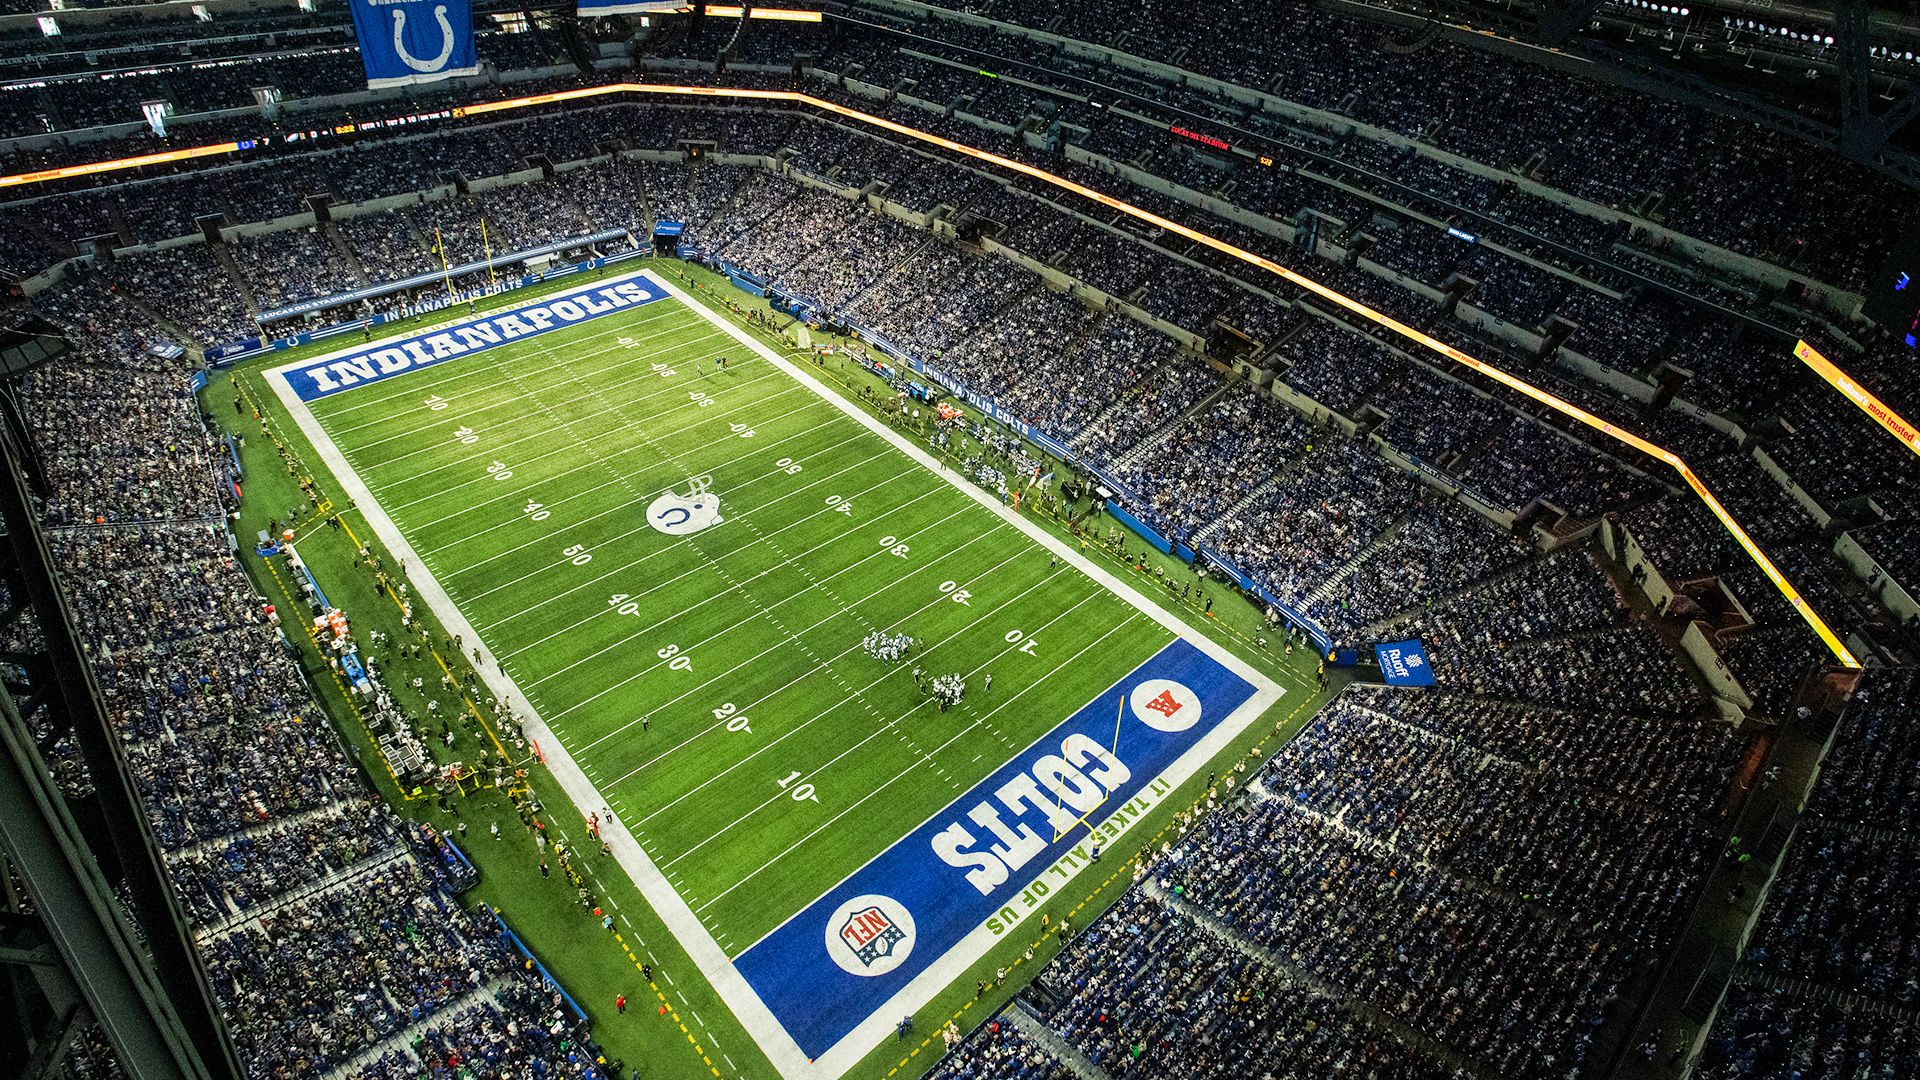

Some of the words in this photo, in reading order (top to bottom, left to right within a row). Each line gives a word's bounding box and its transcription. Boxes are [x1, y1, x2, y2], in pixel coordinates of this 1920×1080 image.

[1171, 126, 1189, 138] LUCAS
[1189, 132, 1199, 141] OIL
[1200, 136, 1229, 150] STADIUM
[39, 171, 60, 179] trusted
[552, 239, 576, 249] LUCAS
[589, 229, 622, 241] STADIUM
[263, 307, 294, 319] LUCAS
[294, 303, 311, 312] OIL
[312, 293, 355, 307] STADIUM
[383, 290, 481, 323] INDIANAPOLIS
[485, 278, 523, 297] COLTS
[401, 318, 456, 340] SALUTE
[489, 296, 546, 316] SERVICE
[307, 282, 652, 393] INDIANAPOLIS
[1461, 355, 1480, 368] trusted
[424, 395, 449, 411] 10
[1837, 377, 1869, 406] Indiana's
[1868, 403, 1887, 421] most
[1887, 417, 1915, 442] trusted
[453, 426, 479, 444] 20
[996, 409, 1029, 435] COLTS
[487, 460, 513, 480] 30
[775, 457, 803, 475] 50
[1420, 462, 1438, 476] TEXT
[523, 500, 550, 521] 40
[825, 495, 853, 515] 40
[562, 543, 592, 566] 50
[879, 535, 909, 557] 30
[608, 593, 639, 616] 40
[938, 580, 972, 604] 20
[1004, 629, 1039, 655] 10
[657, 644, 691, 671] 30
[1381, 650, 1396, 679] MORTGAGE
[1388, 648, 1409, 677] Ruoff
[712, 703, 749, 732] 20
[777, 770, 815, 801] 10
[1149, 777, 1171, 797] IT
[931, 733, 1131, 896] COLTS
[1091, 797, 1150, 847] TAKES
[1049, 845, 1089, 878] ALL
[1022, 880, 1049, 907] OF
[843, 909, 889, 946] NFL
[986, 906, 1020, 935] US
